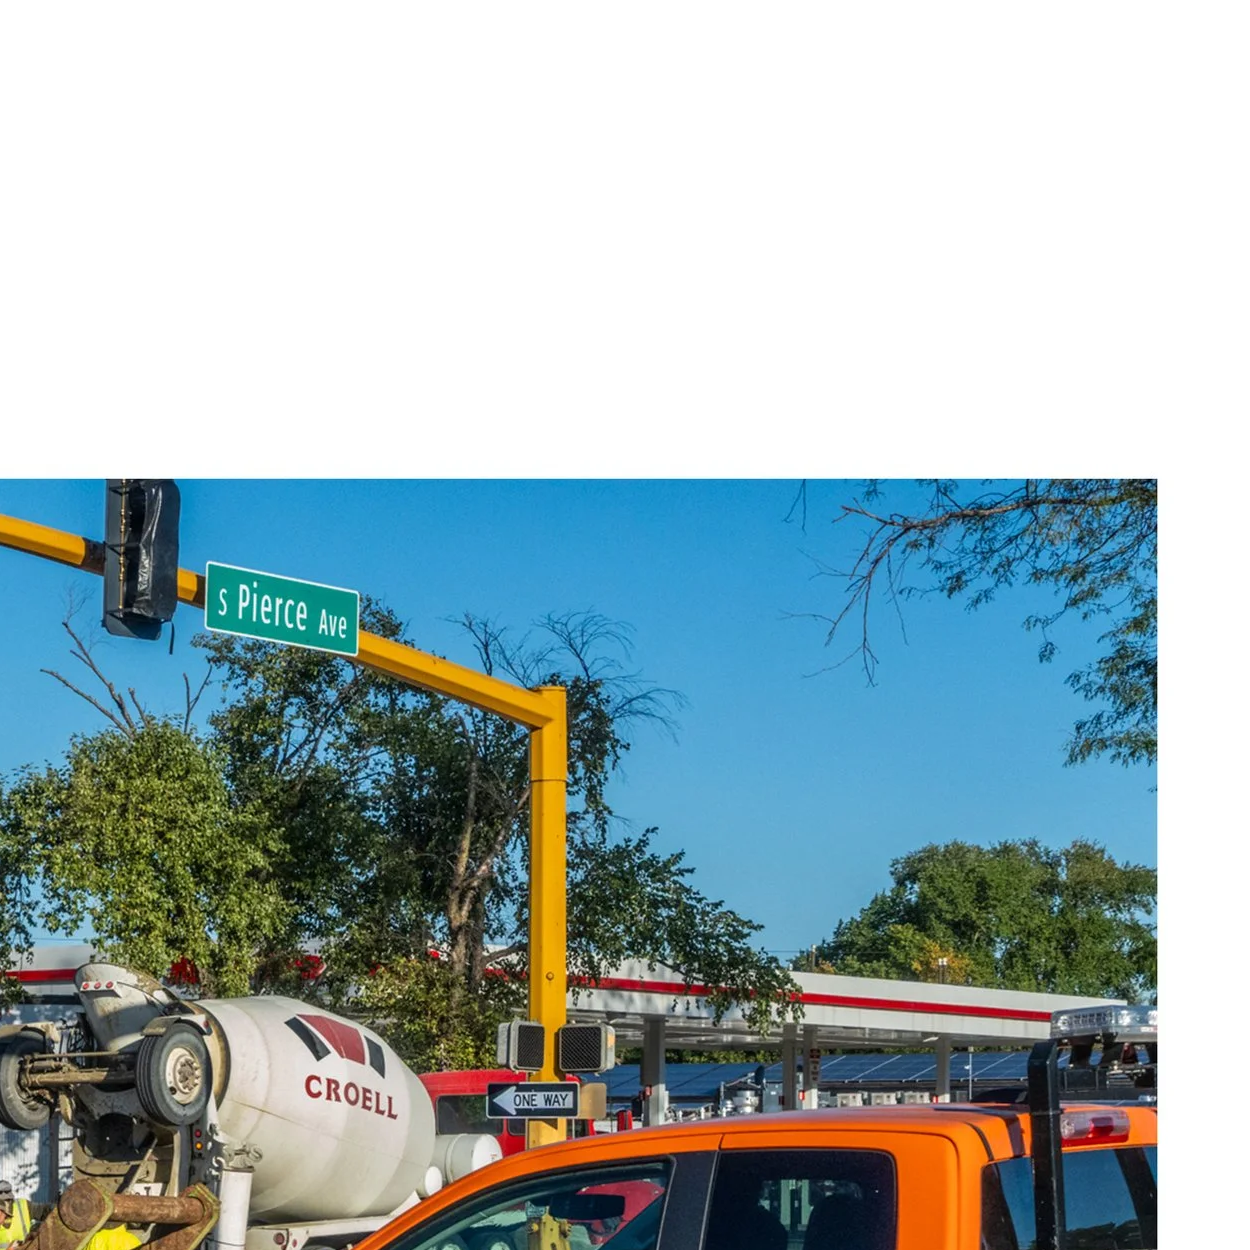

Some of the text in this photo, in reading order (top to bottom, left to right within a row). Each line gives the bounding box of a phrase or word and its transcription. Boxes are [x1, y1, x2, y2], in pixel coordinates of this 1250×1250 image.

[218, 581, 347, 639] S Pierce Ave
[305, 1074, 398, 1120] CROELL
[513, 1093, 568, 1107] ONE WAY
